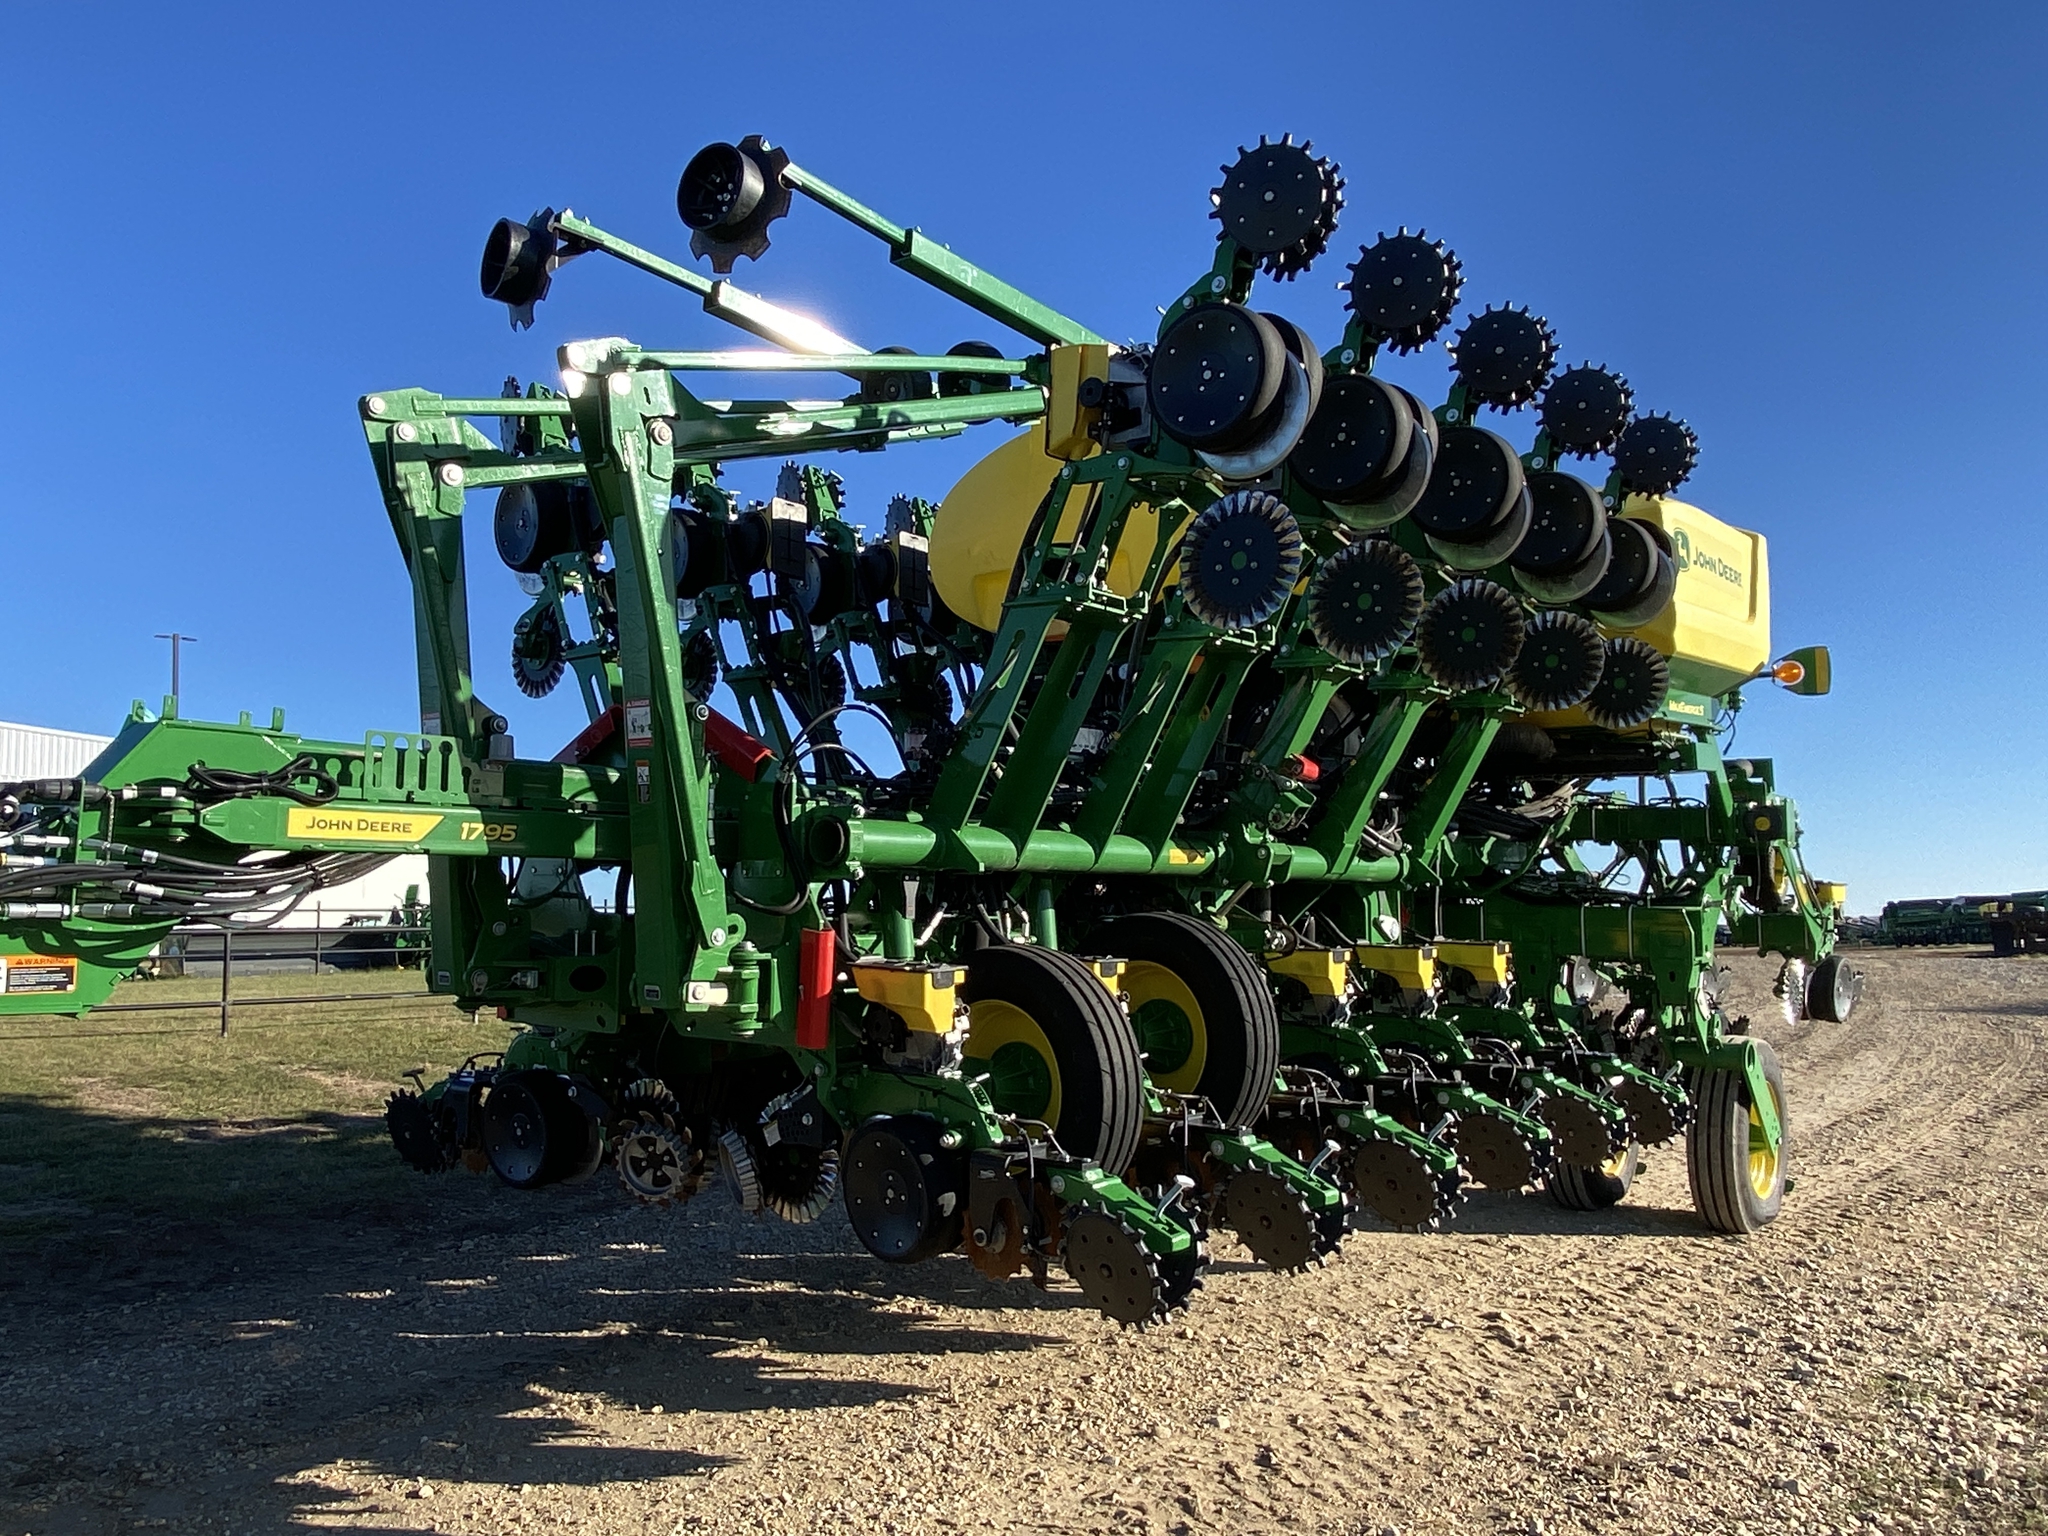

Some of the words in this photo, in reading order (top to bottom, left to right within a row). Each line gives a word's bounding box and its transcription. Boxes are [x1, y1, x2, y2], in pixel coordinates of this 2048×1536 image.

[1693, 546, 1717, 574] JOHN
[1718, 558, 1742, 586] DEERE
[306, 816, 353, 831] JOHN
[357, 820, 413, 834] DEERE
[460, 822, 518, 841] 1795
